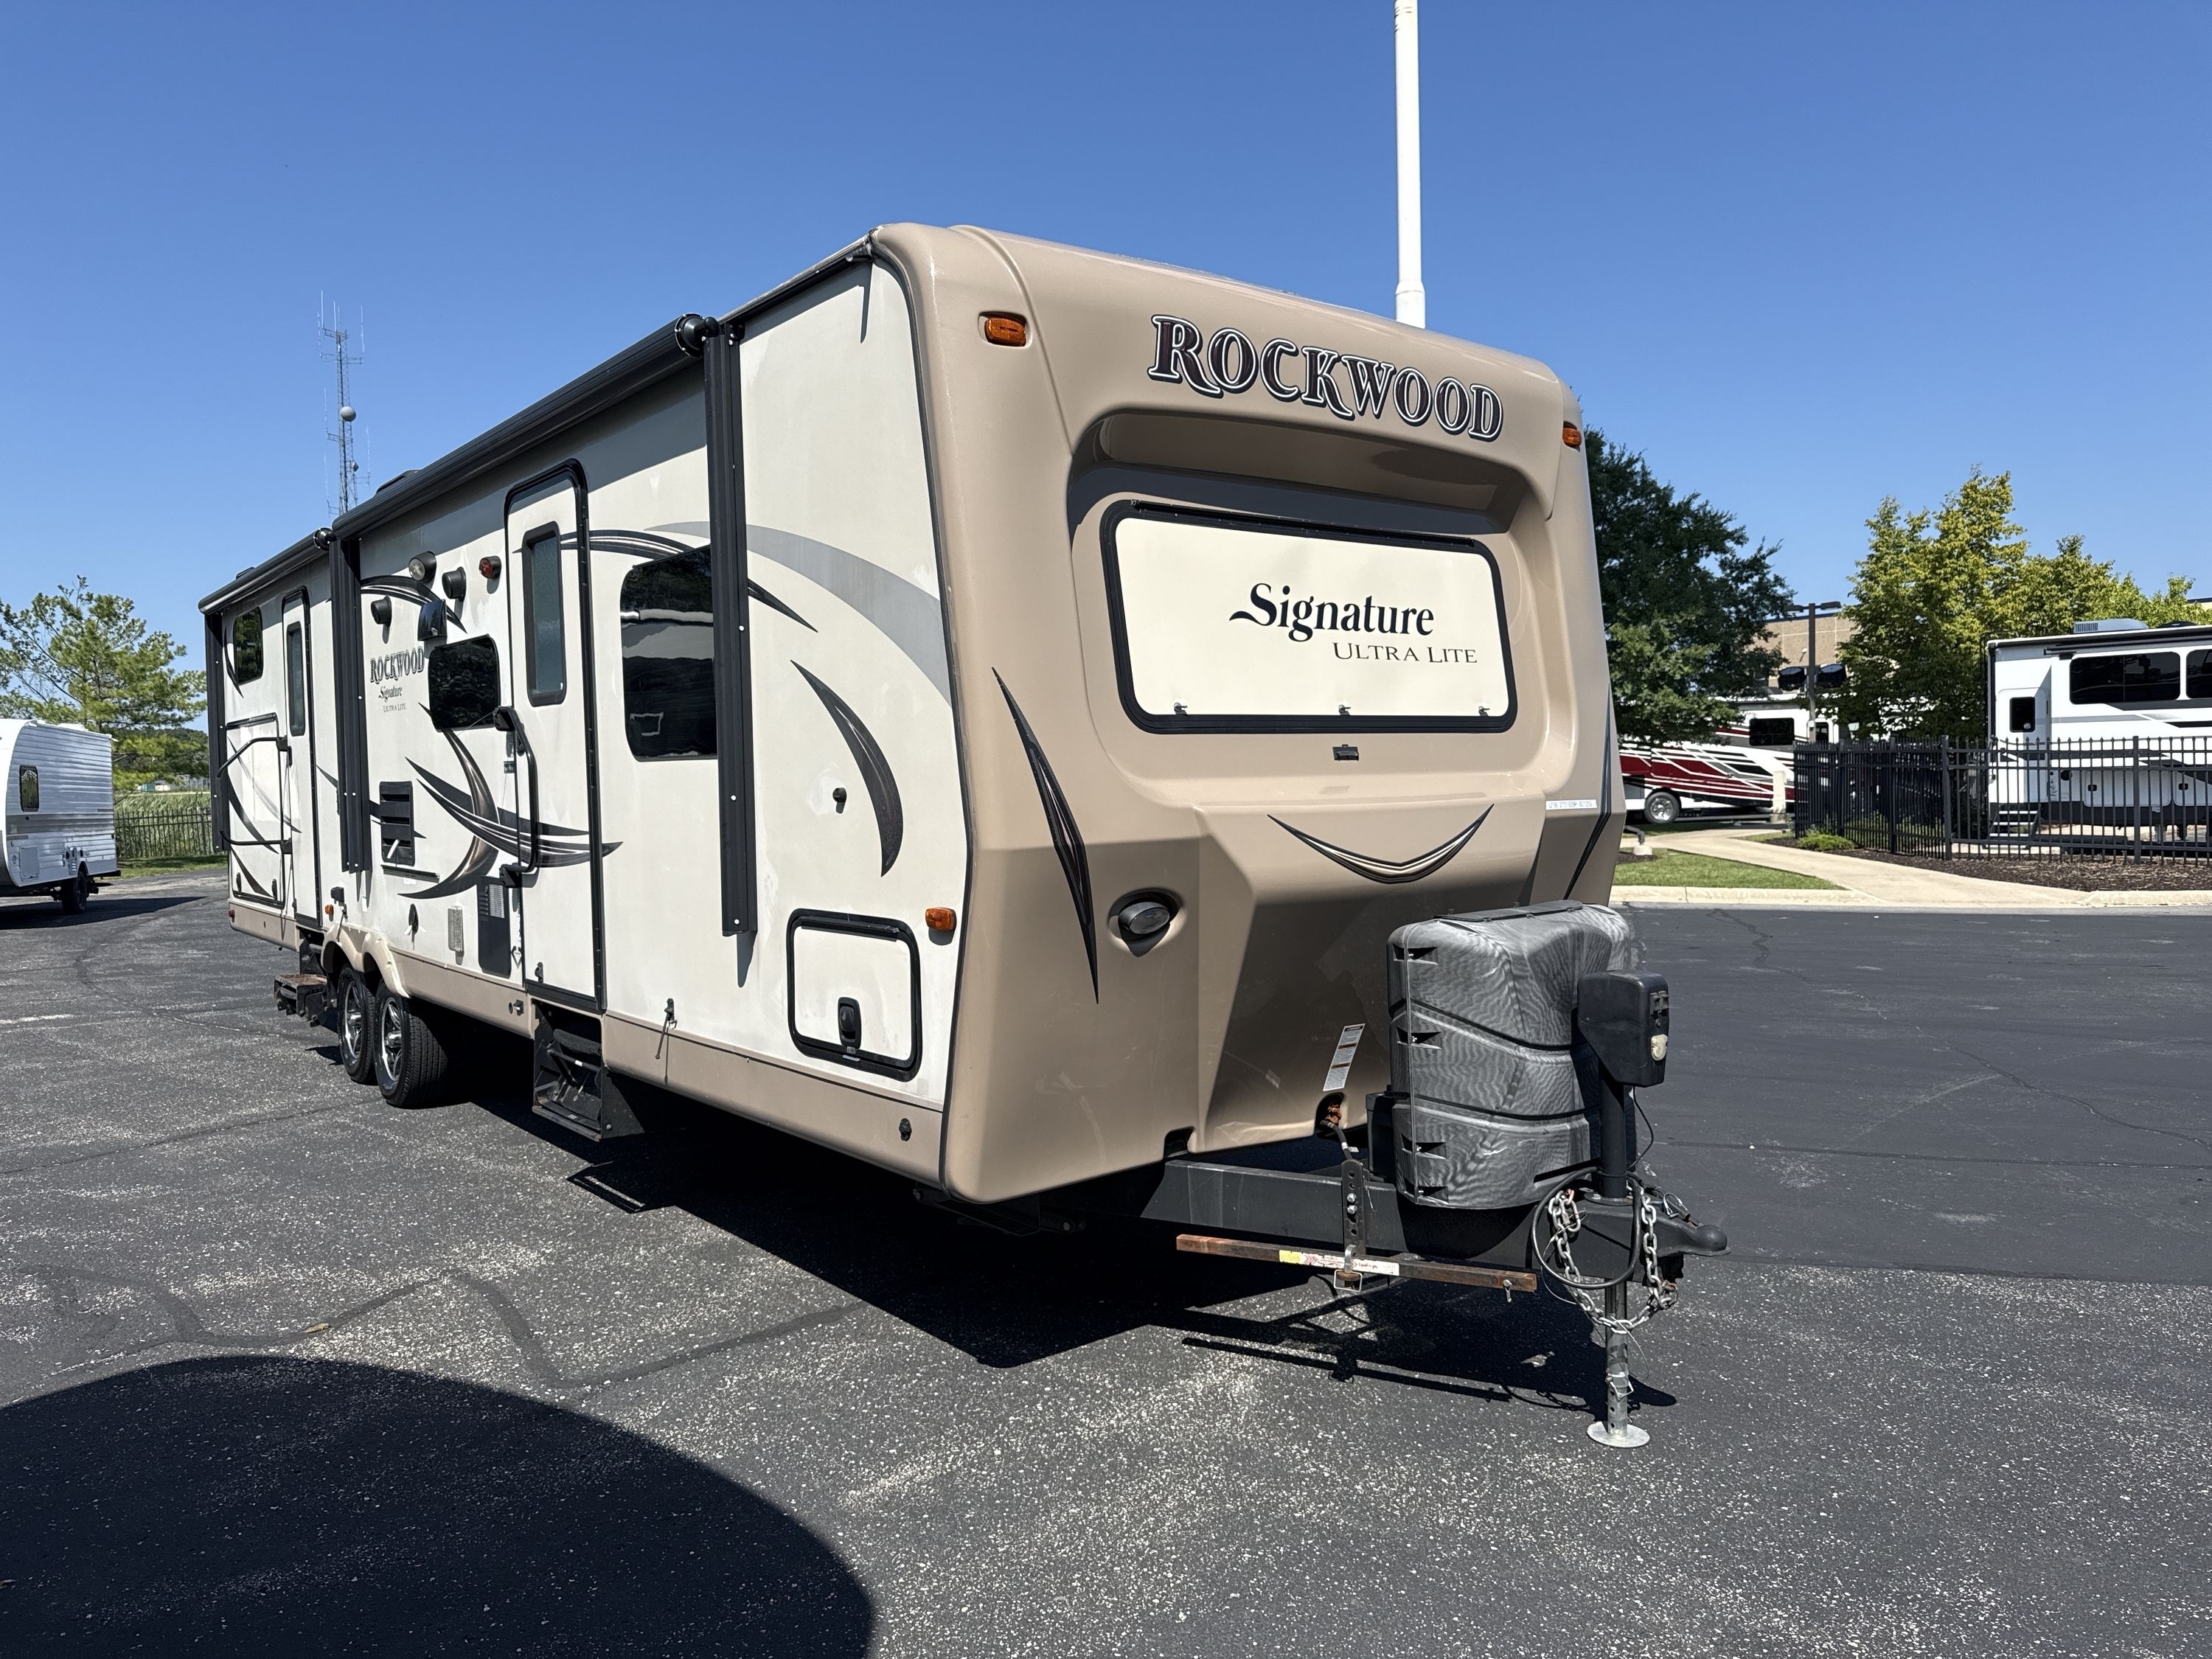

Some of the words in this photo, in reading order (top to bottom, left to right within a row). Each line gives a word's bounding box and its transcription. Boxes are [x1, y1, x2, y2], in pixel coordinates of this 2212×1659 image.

[1147, 314, 1503, 442] ROCKWOOD
[1229, 582, 1434, 642] Signature
[370, 646, 425, 684] ROCKWOOD
[1333, 642, 1419, 661] ULTRA
[1427, 647, 1478, 664] LITE
[378, 685, 403, 703] Signature
[383, 704, 397, 712] ULTRA
[397, 703, 406, 712] LITE
